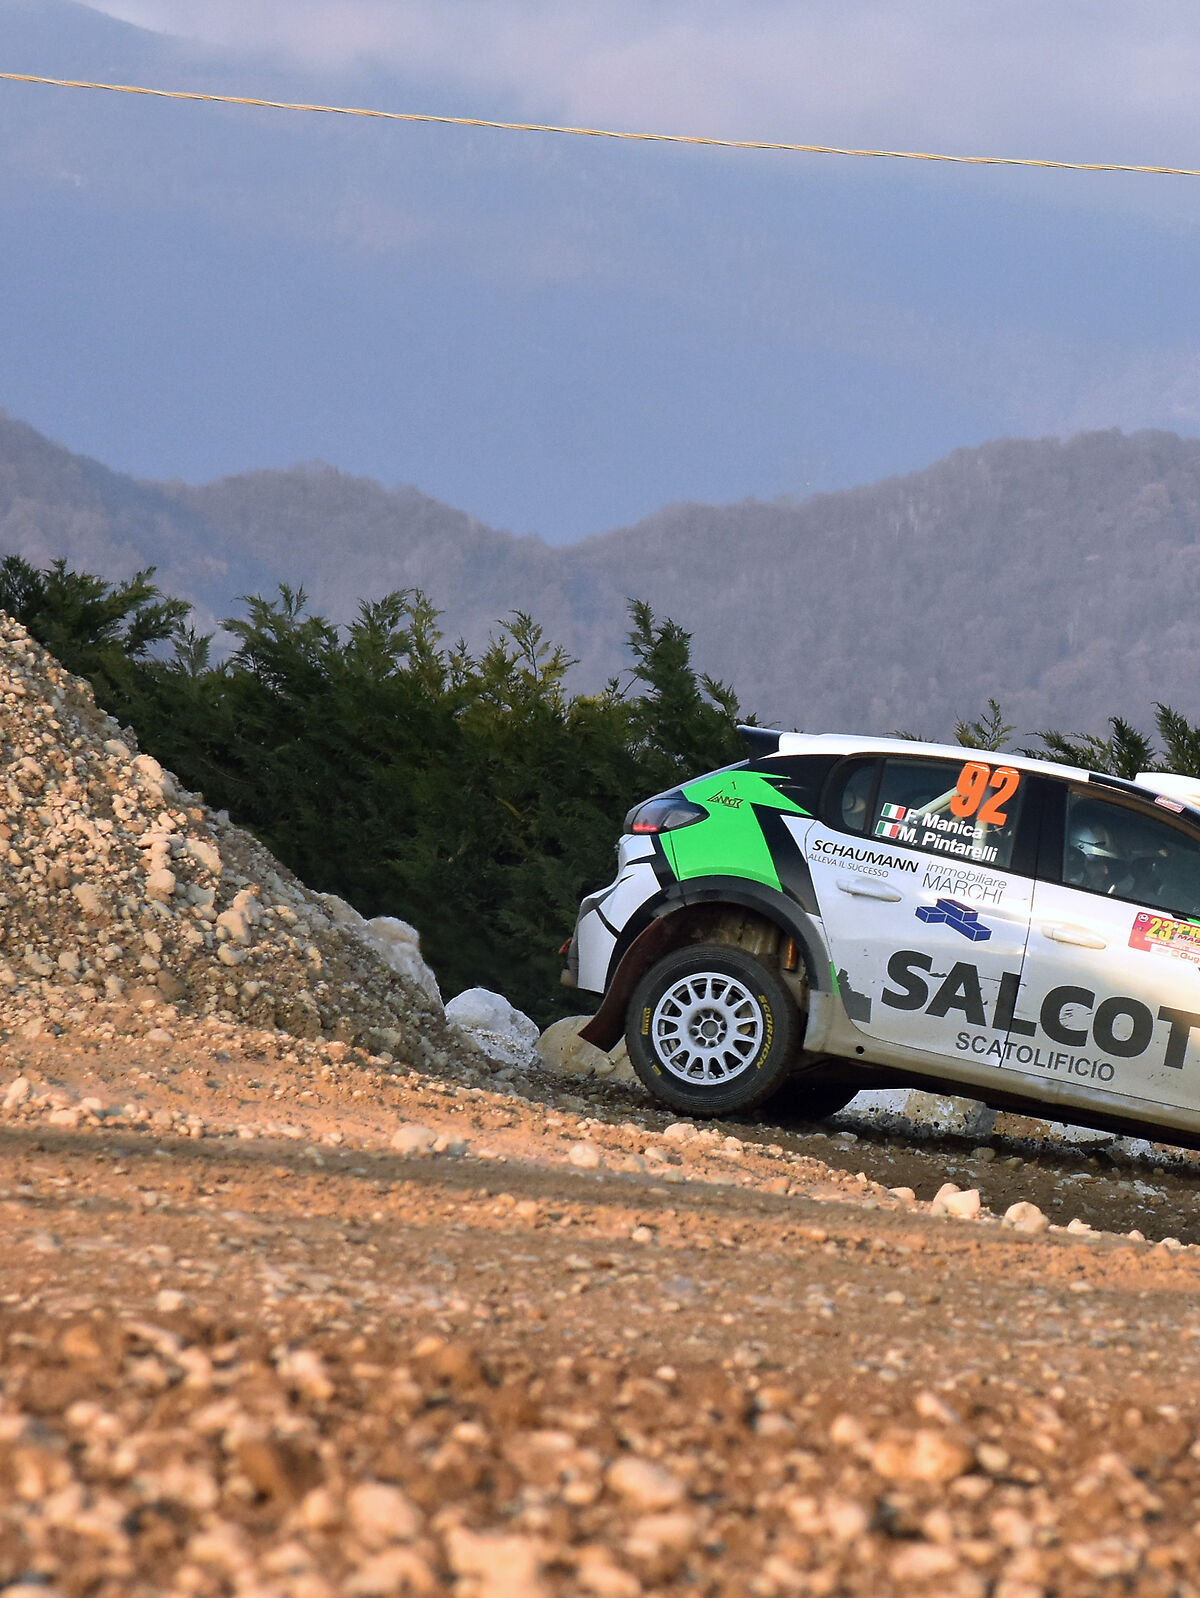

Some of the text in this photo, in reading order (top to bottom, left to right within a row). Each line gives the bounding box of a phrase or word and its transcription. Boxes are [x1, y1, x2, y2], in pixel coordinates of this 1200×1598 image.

[950, 761, 1020, 826] 92
[905, 808, 984, 840] F. Manica
[812, 839, 919, 873] SCHAUMANN
[899, 827, 998, 862] M. Pintarelli
[808, 852, 889, 878] ALLEVA IL SUCCESSO
[926, 861, 1008, 890] immobiliare
[922, 873, 1004, 905] MARCHI
[758, 994, 775, 1069] SCORPION
[955, 1031, 1115, 1082] SCATOLIFICIO
